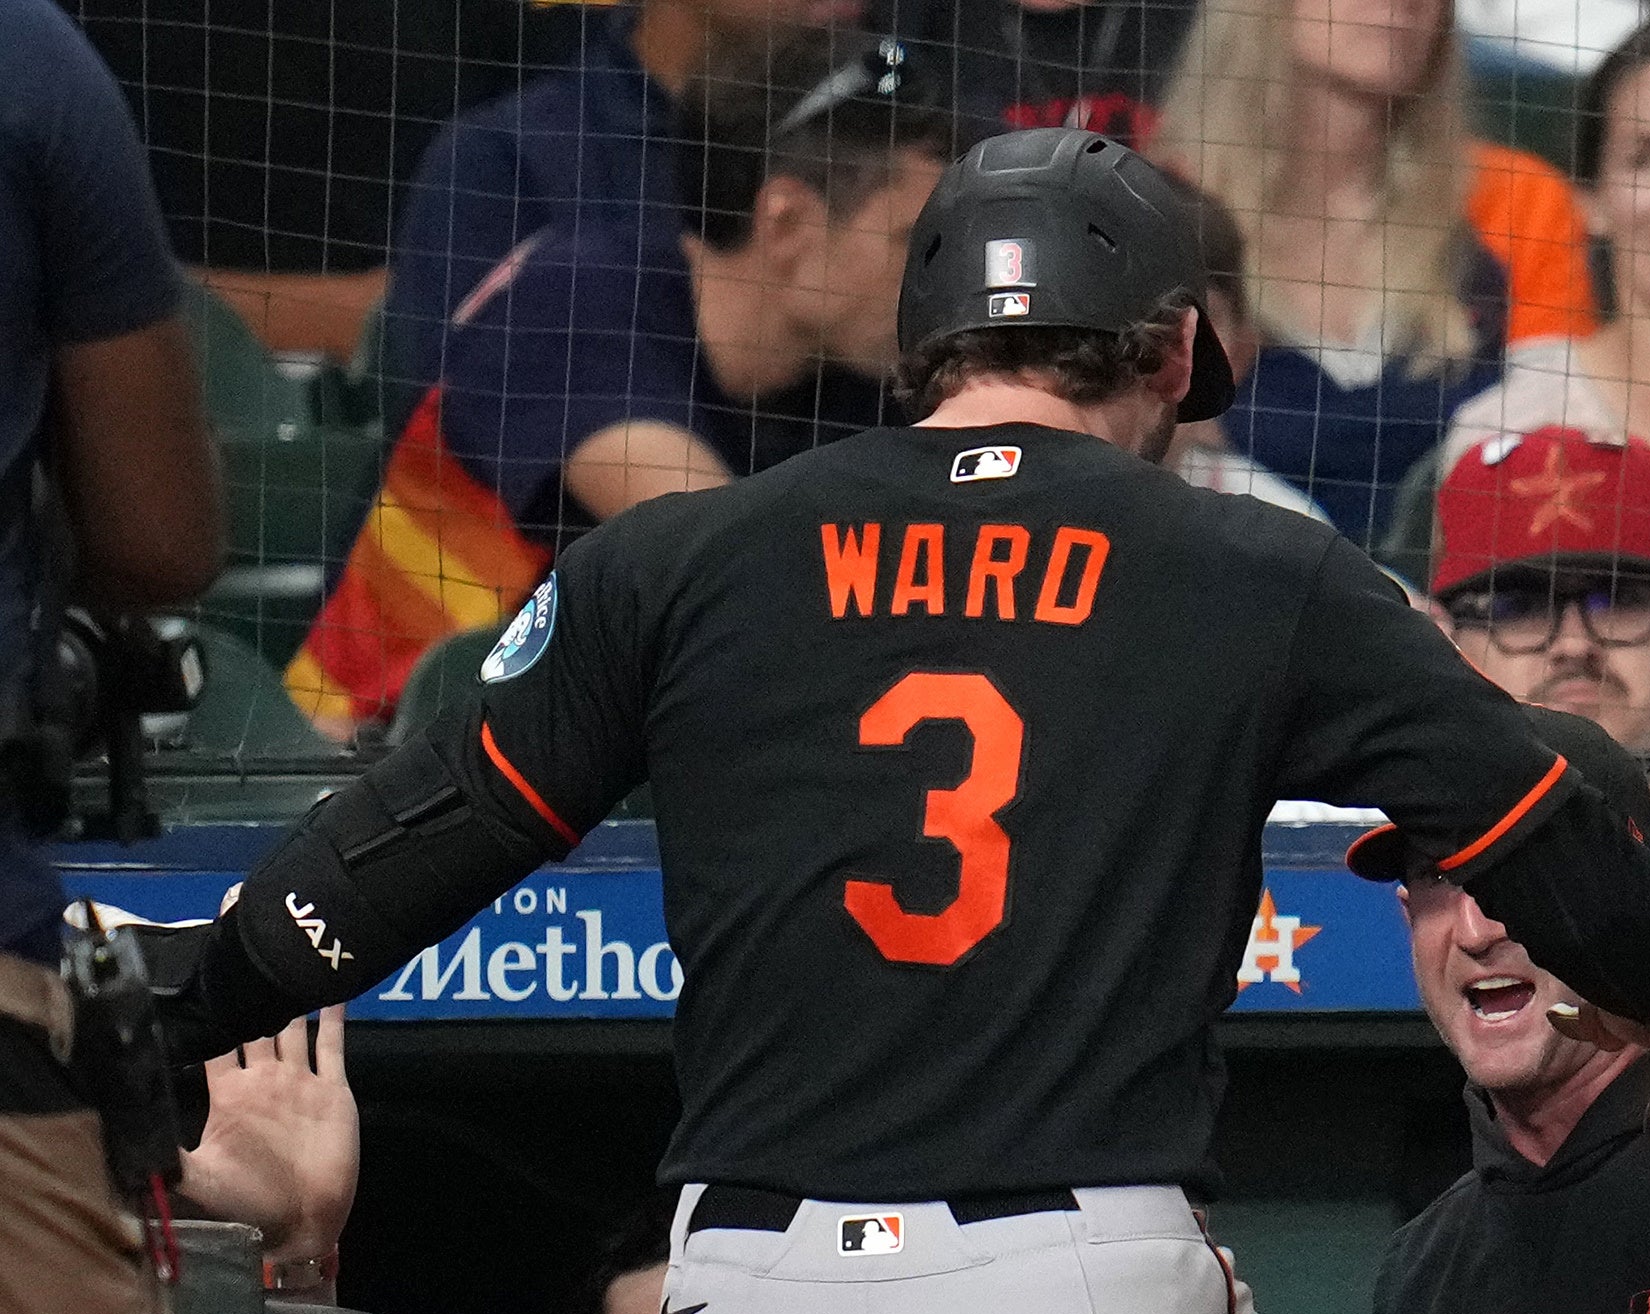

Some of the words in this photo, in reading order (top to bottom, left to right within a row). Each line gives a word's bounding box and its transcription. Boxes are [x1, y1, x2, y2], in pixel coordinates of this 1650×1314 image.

[999, 242, 1022, 284] 3
[821, 523, 1111, 626] WARD
[844, 672, 1024, 964] 3
[285, 892, 355, 971] JAX
[378, 909, 685, 1002] Metho
